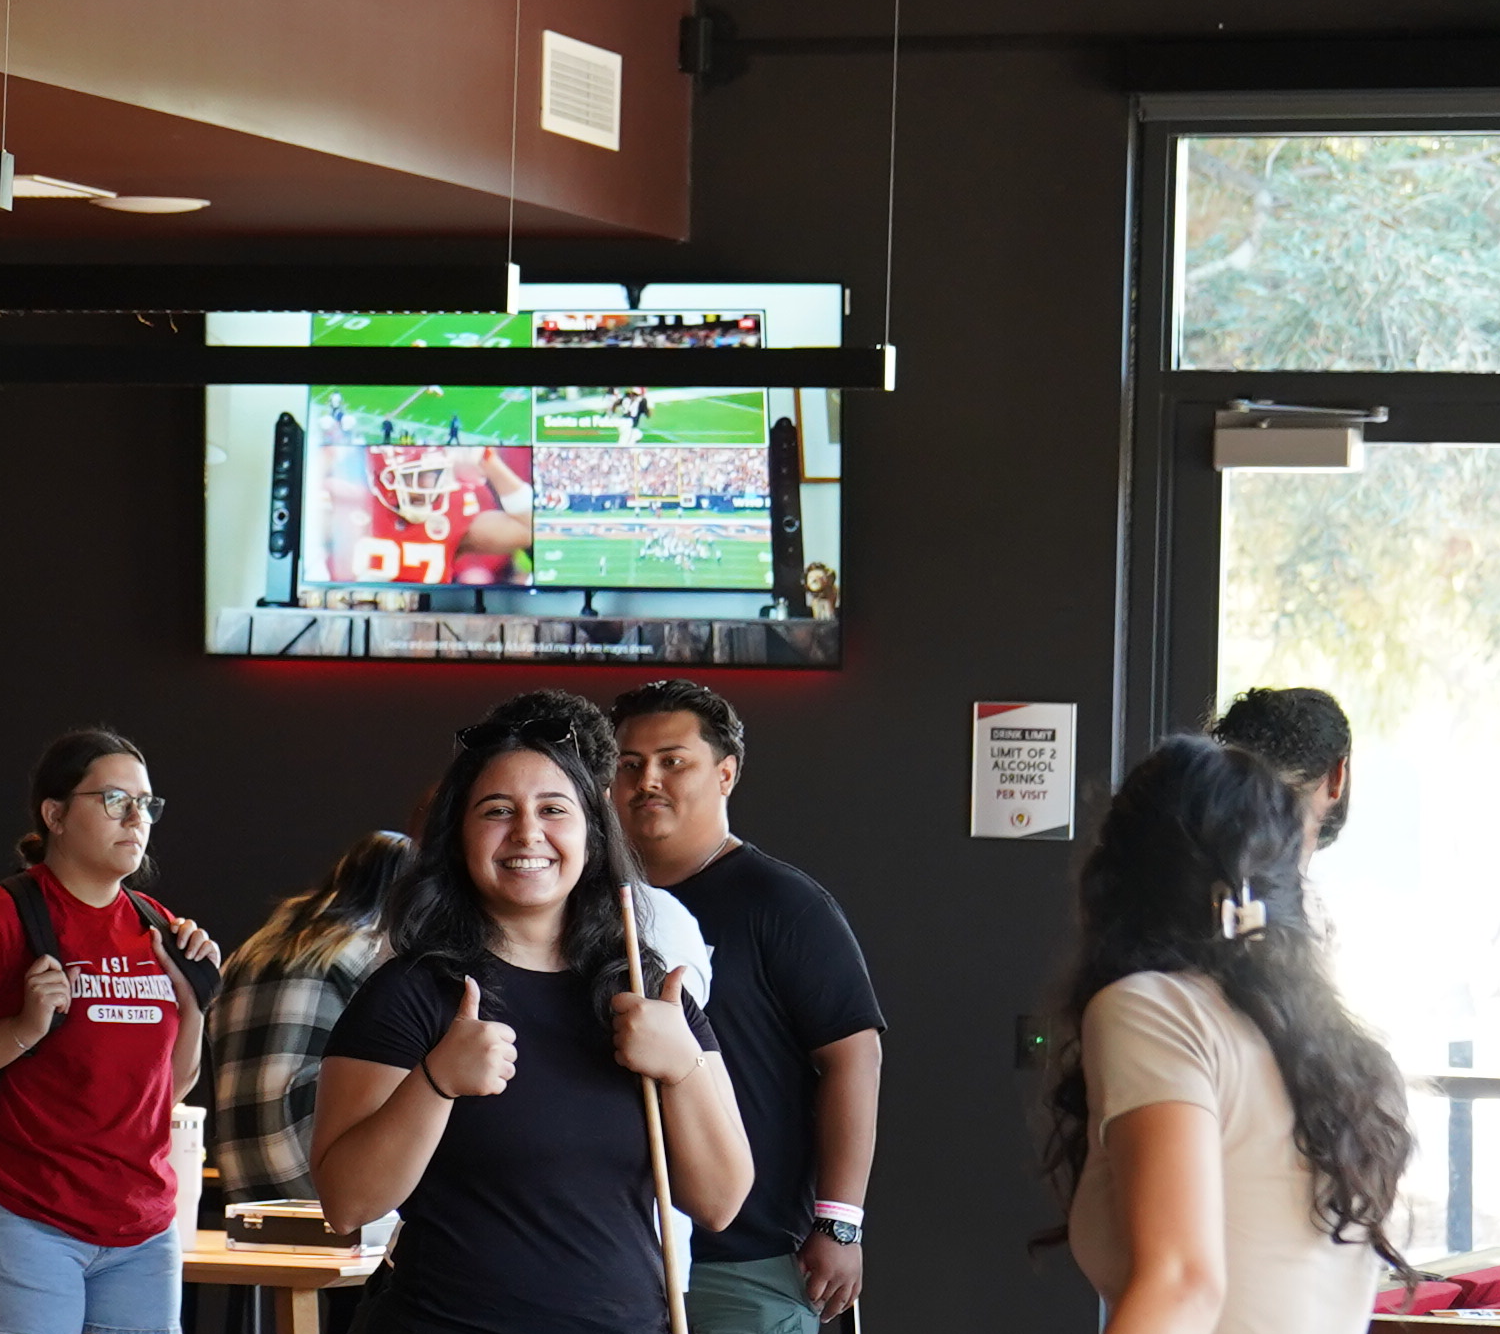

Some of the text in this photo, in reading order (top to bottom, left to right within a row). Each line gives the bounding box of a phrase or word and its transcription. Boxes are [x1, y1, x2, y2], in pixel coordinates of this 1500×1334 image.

[993, 729, 1053, 740] DRINK LIMIT
[990, 747, 1057, 760] LIMIT OF 2
[992, 760, 1055, 773] ALCOHOL
[999, 773, 1045, 785] DRINKS
[996, 789, 1048, 800] PER VISIT
[98, 1008, 155, 1020] STAN STATE
